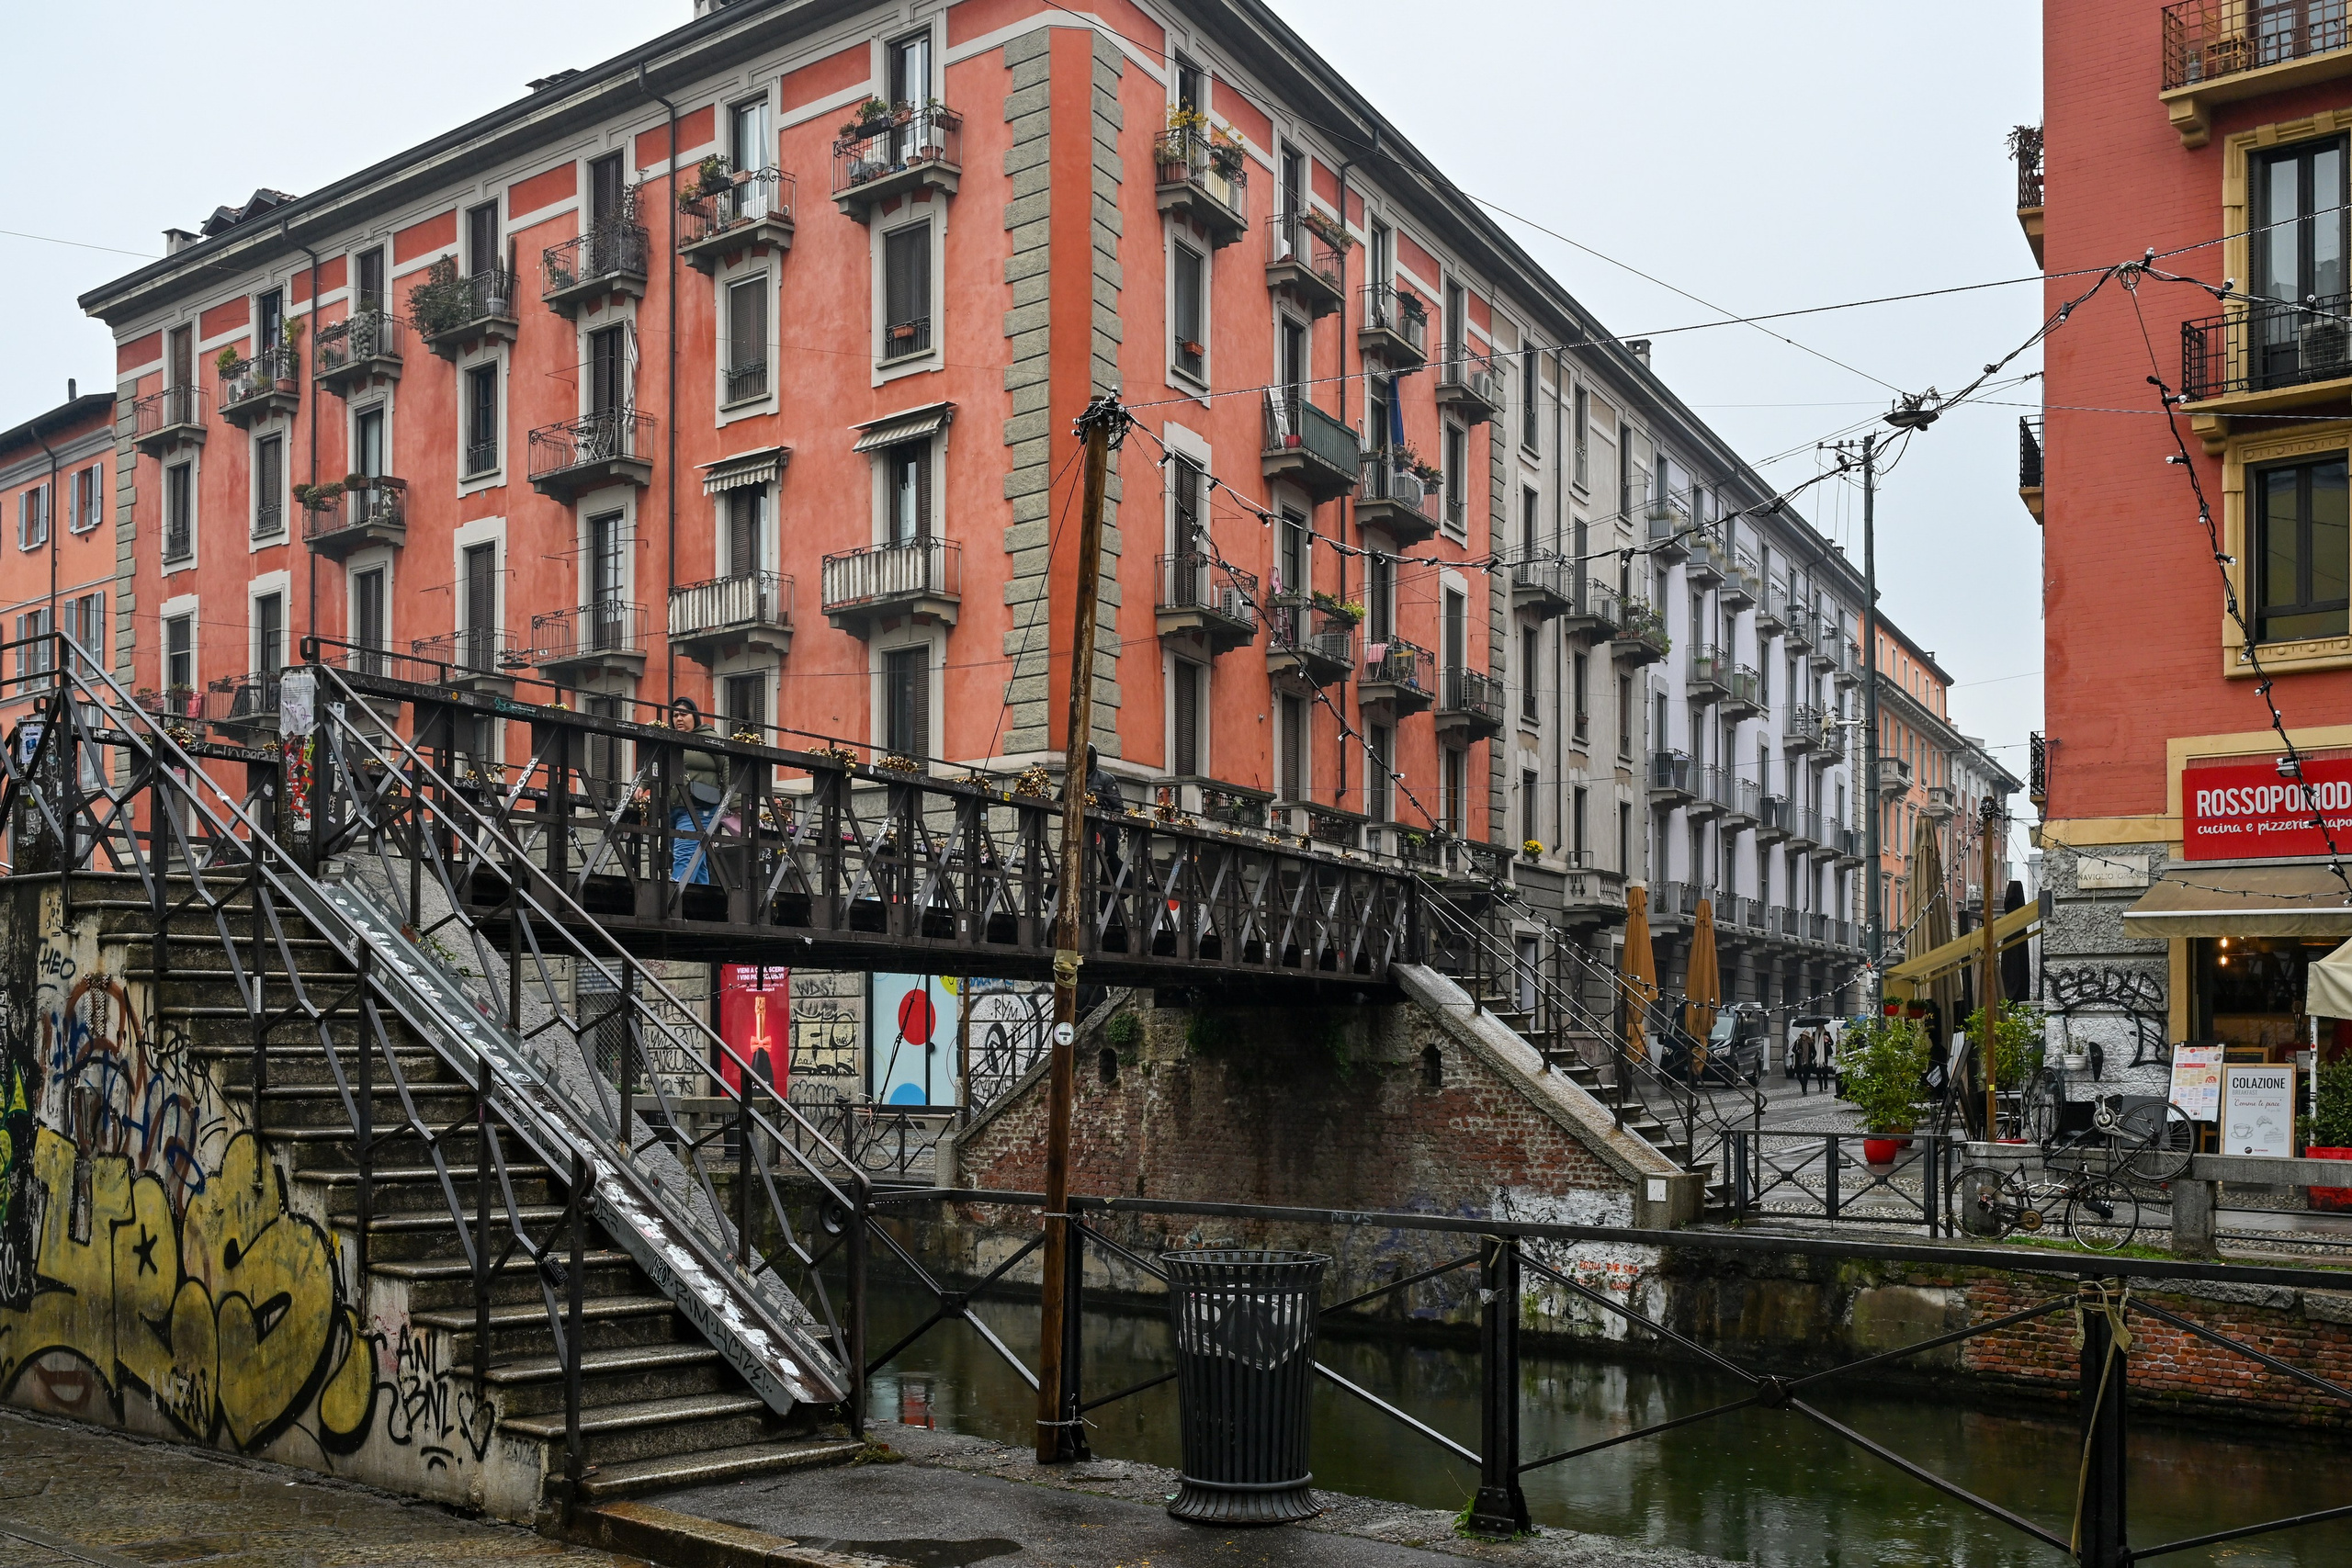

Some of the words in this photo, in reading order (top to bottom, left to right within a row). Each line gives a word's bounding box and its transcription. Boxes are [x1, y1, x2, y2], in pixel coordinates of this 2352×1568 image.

[2197, 822, 2243, 835] cucina
[2245, 822, 2254, 833] e
[2077, 873, 2114, 882] NAVIGLIO
[2117, 871, 2149, 880] GRANDE
[2232, 1077, 2286, 1089] COLAZIONE
[1578, 1259, 1601, 1271] FROM
[1605, 1262, 1621, 1273] THE
[1623, 1264, 1640, 1275] SEA
[1609, 1281, 1643, 1292] MARKT
